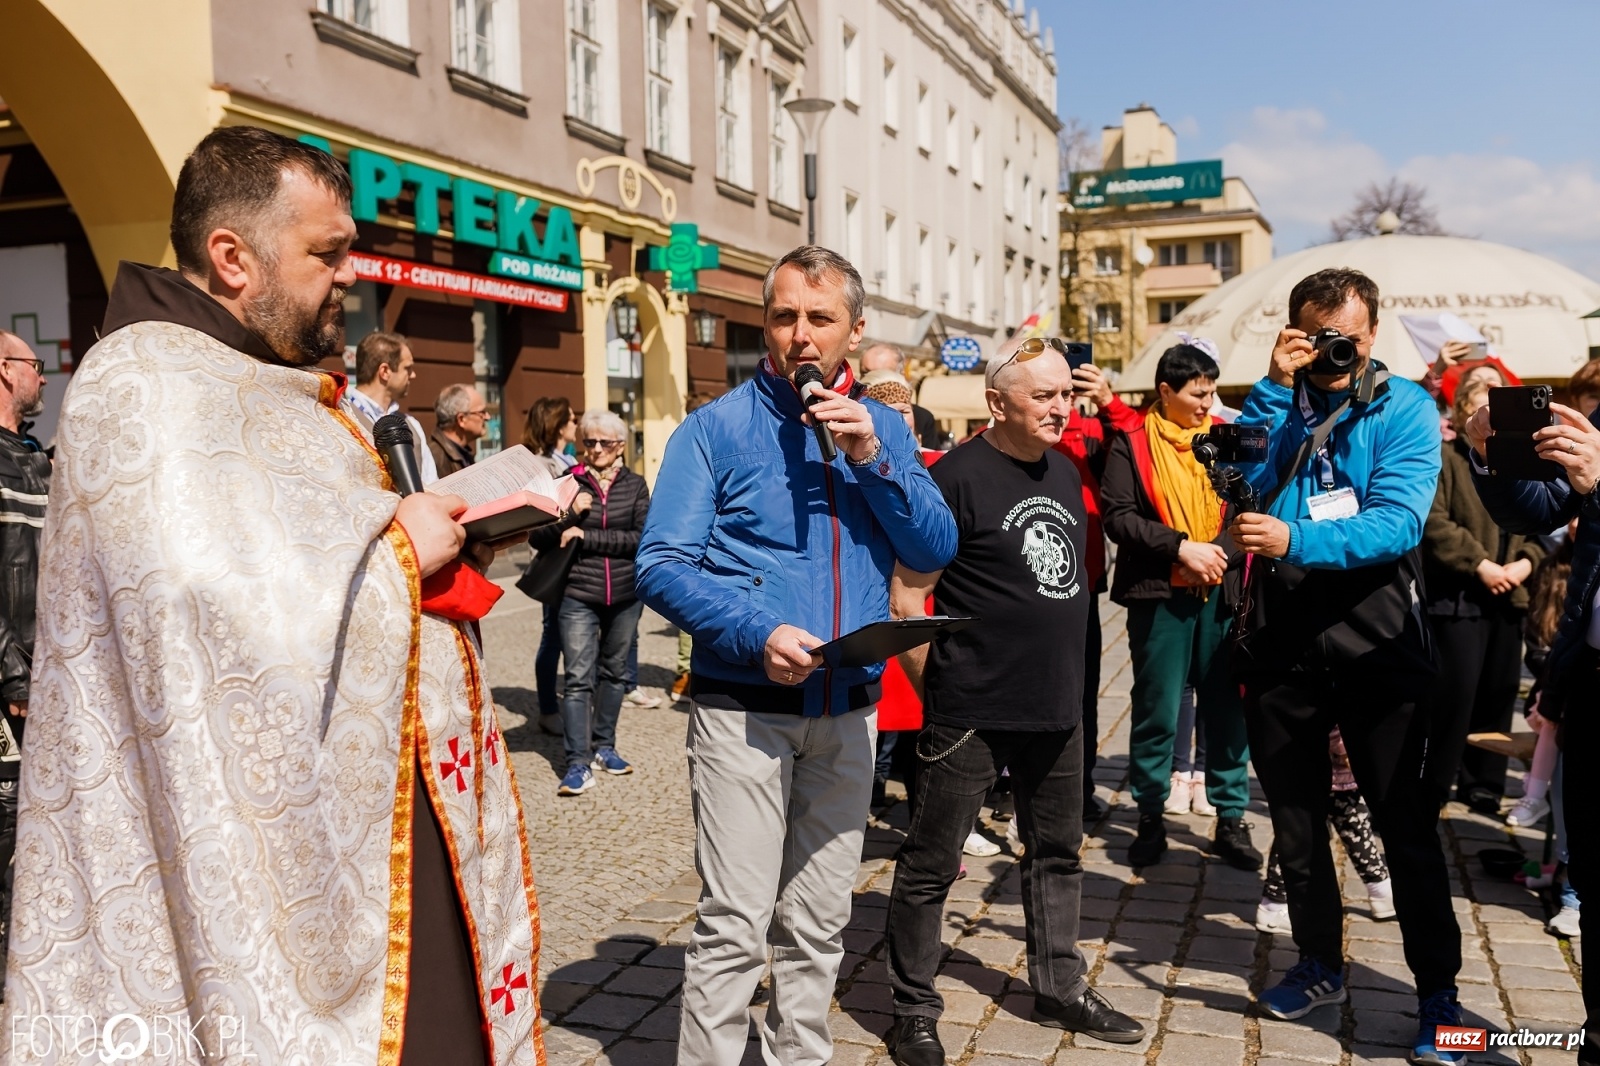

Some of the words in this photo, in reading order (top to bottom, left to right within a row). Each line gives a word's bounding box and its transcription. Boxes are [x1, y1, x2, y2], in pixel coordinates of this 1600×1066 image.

[297, 134, 582, 267] PTEKA
[349, 256, 382, 278] NEK
[385, 262, 402, 281] 12
[411, 267, 471, 292] CENTRUM
[502, 257, 530, 275] POD
[533, 263, 581, 286] RÓŻAMI
[1380, 295, 1450, 309] OWAR
[1001, 520, 1011, 531] 25
